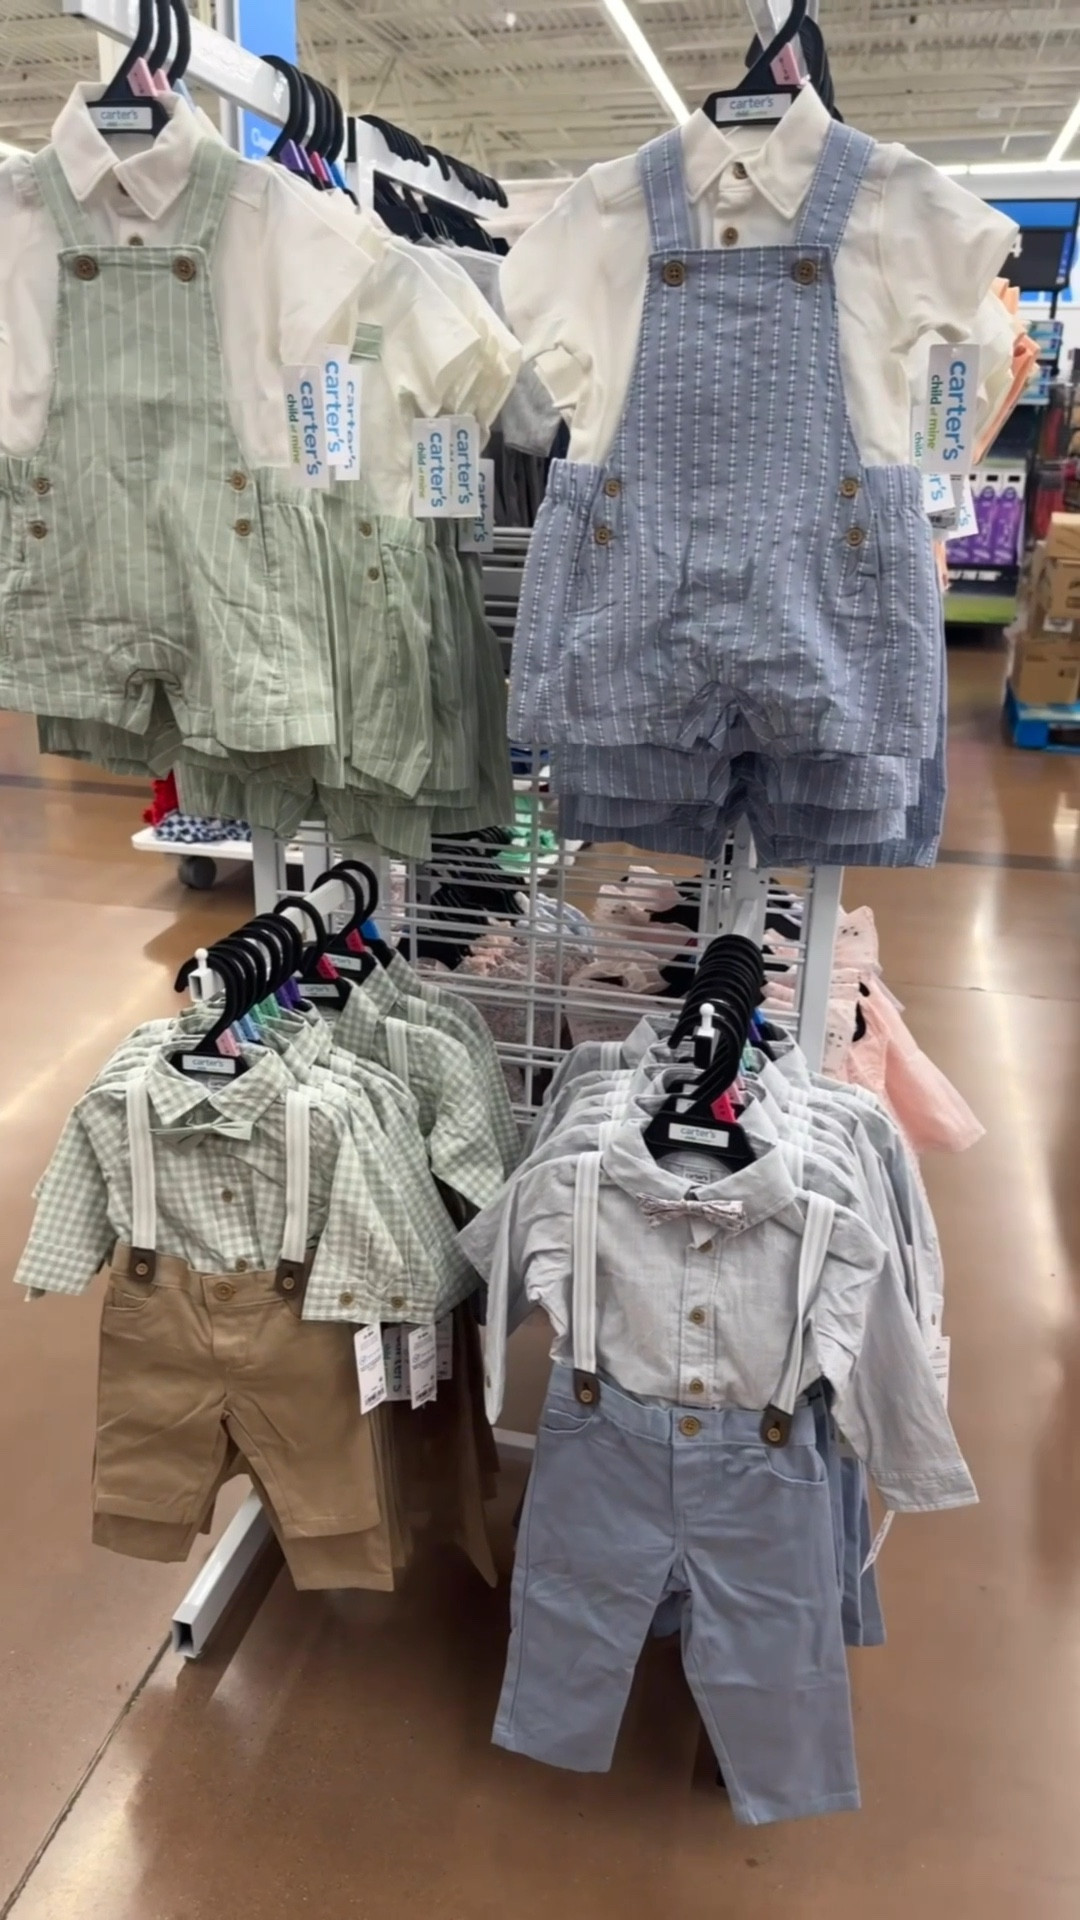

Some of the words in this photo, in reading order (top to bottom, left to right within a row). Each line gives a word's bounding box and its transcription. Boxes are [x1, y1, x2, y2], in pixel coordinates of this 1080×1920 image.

[100, 109, 138, 120] carter's
[729, 96, 774, 110] carter's
[930, 374, 943, 405] child
[287, 393, 299, 423] child
[325, 360, 345, 454] carter's
[943, 360, 967, 462] carter's
[300, 380, 323, 476] carter's
[927, 418, 938, 450] mine
[291, 435, 301, 464] mine
[417, 441, 427, 466] child
[430, 432, 448, 508] carter's
[456, 428, 474, 505] carter's
[680, 1127, 716, 1138] carter's
